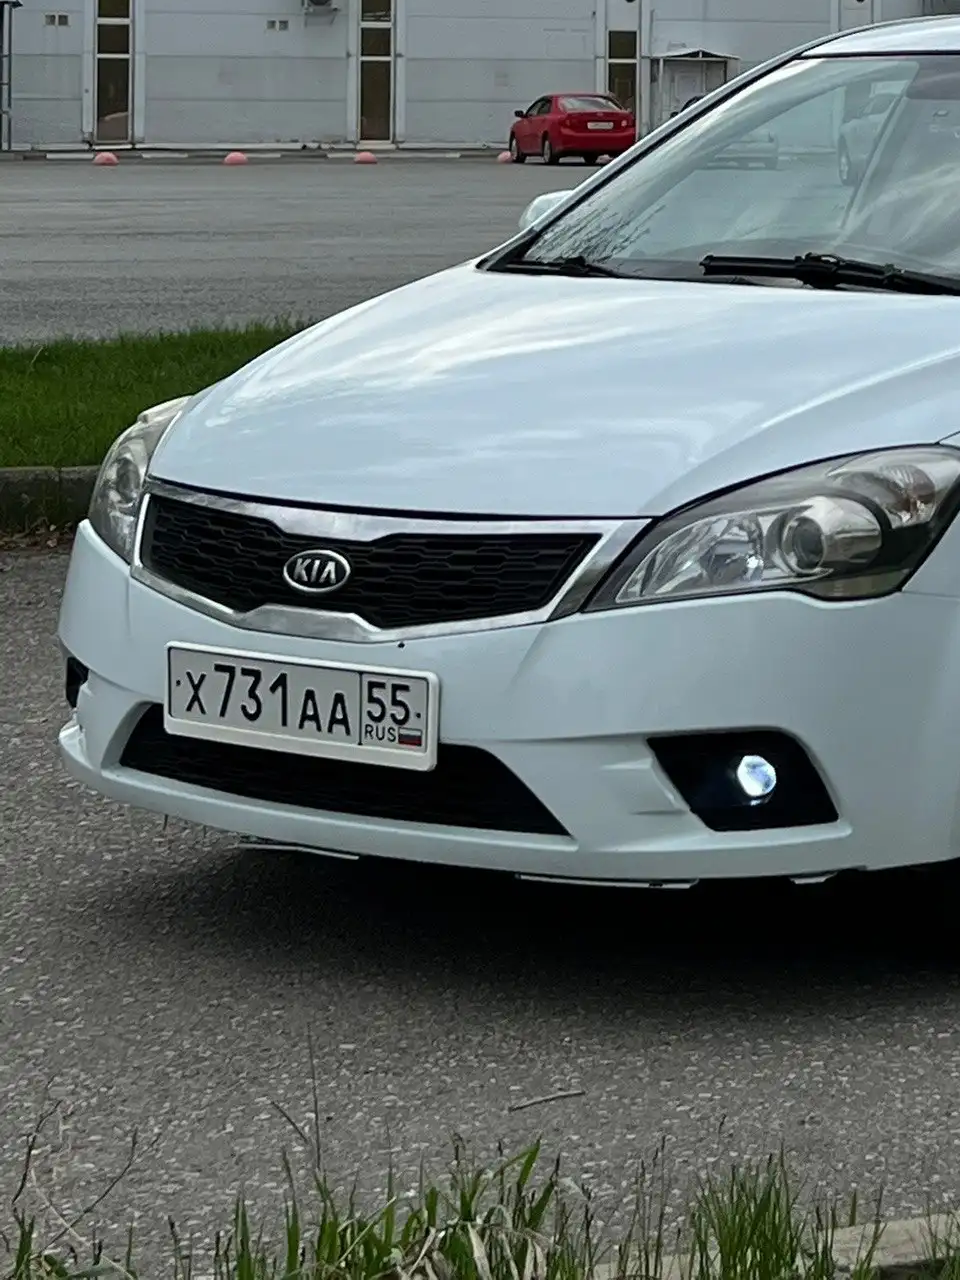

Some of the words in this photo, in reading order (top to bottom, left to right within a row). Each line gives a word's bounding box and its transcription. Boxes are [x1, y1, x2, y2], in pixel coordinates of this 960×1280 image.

[293, 558, 336, 584] KIA
[366, 680, 411, 726] 55
[364, 723, 397, 743] RUS
